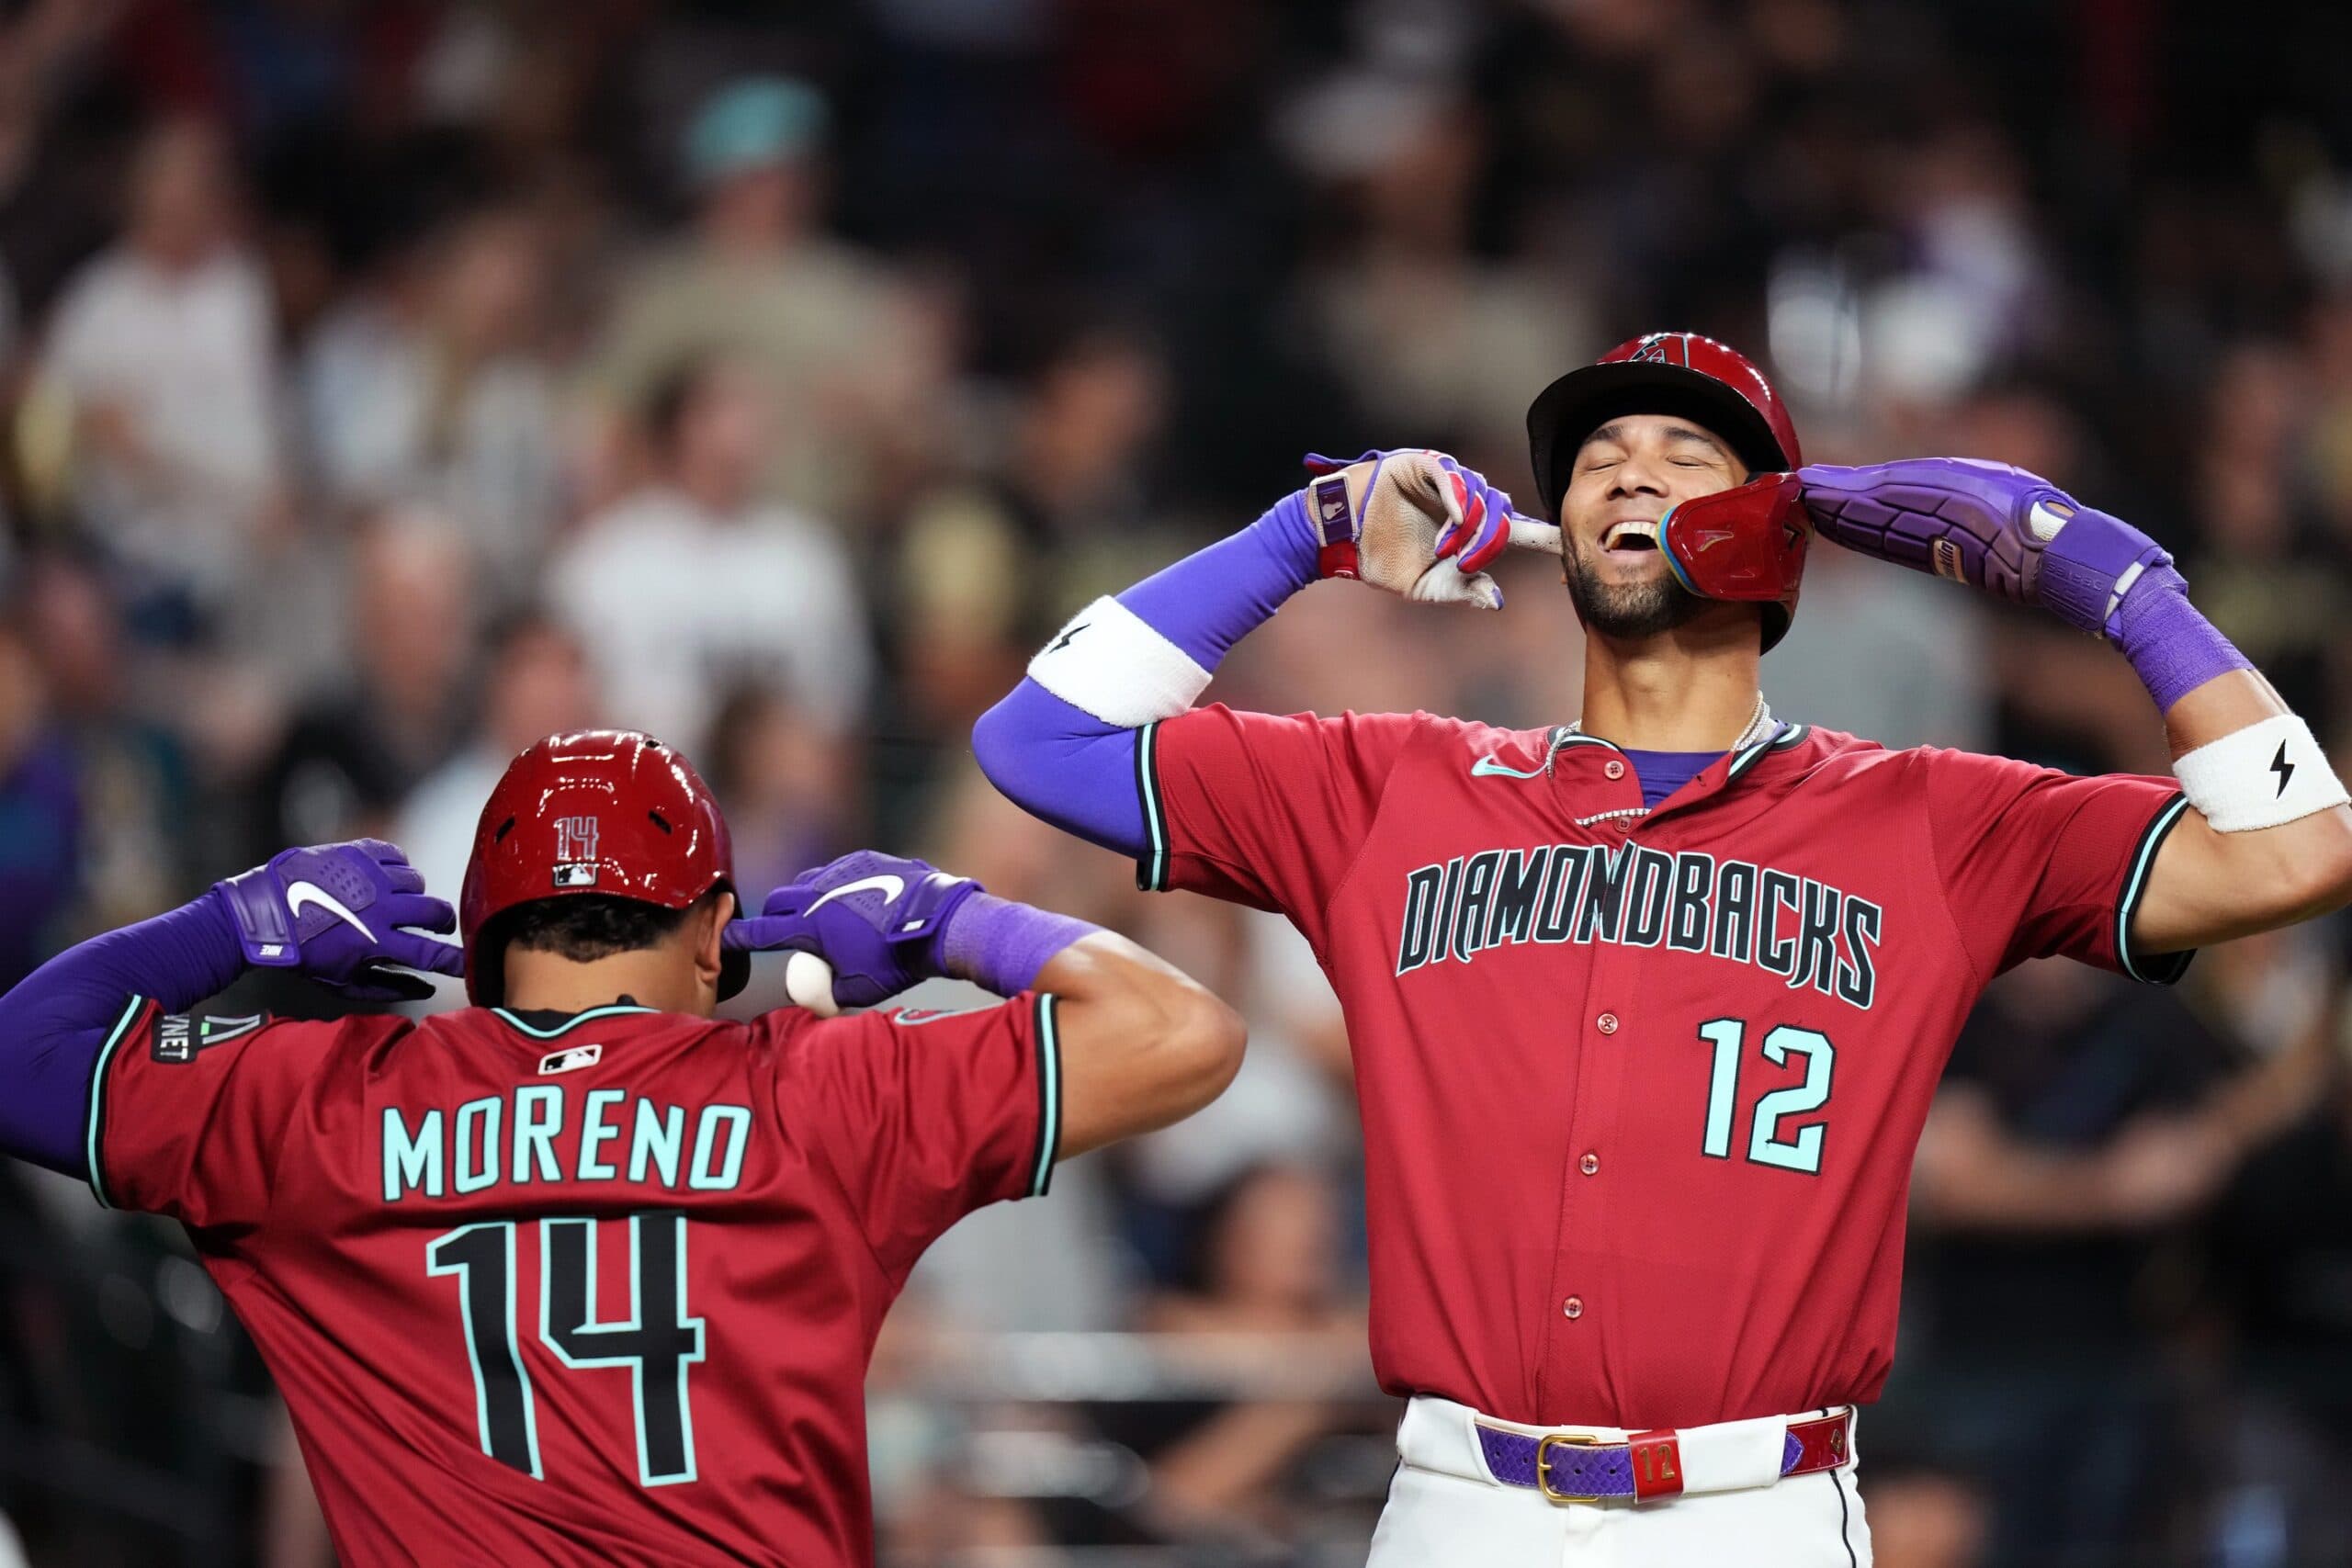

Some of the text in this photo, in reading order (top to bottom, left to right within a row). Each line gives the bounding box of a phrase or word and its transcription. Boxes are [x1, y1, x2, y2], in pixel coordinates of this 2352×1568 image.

[553, 816, 600, 861] 14
[1396, 839, 1882, 1010] DIAMONDBACKS
[160, 1013, 190, 1059] VNET
[382, 1085, 752, 1201] MORENO
[1698, 1017, 1836, 1176] 12
[425, 1210, 706, 1488] 14
[1639, 1443, 1676, 1483] 12
